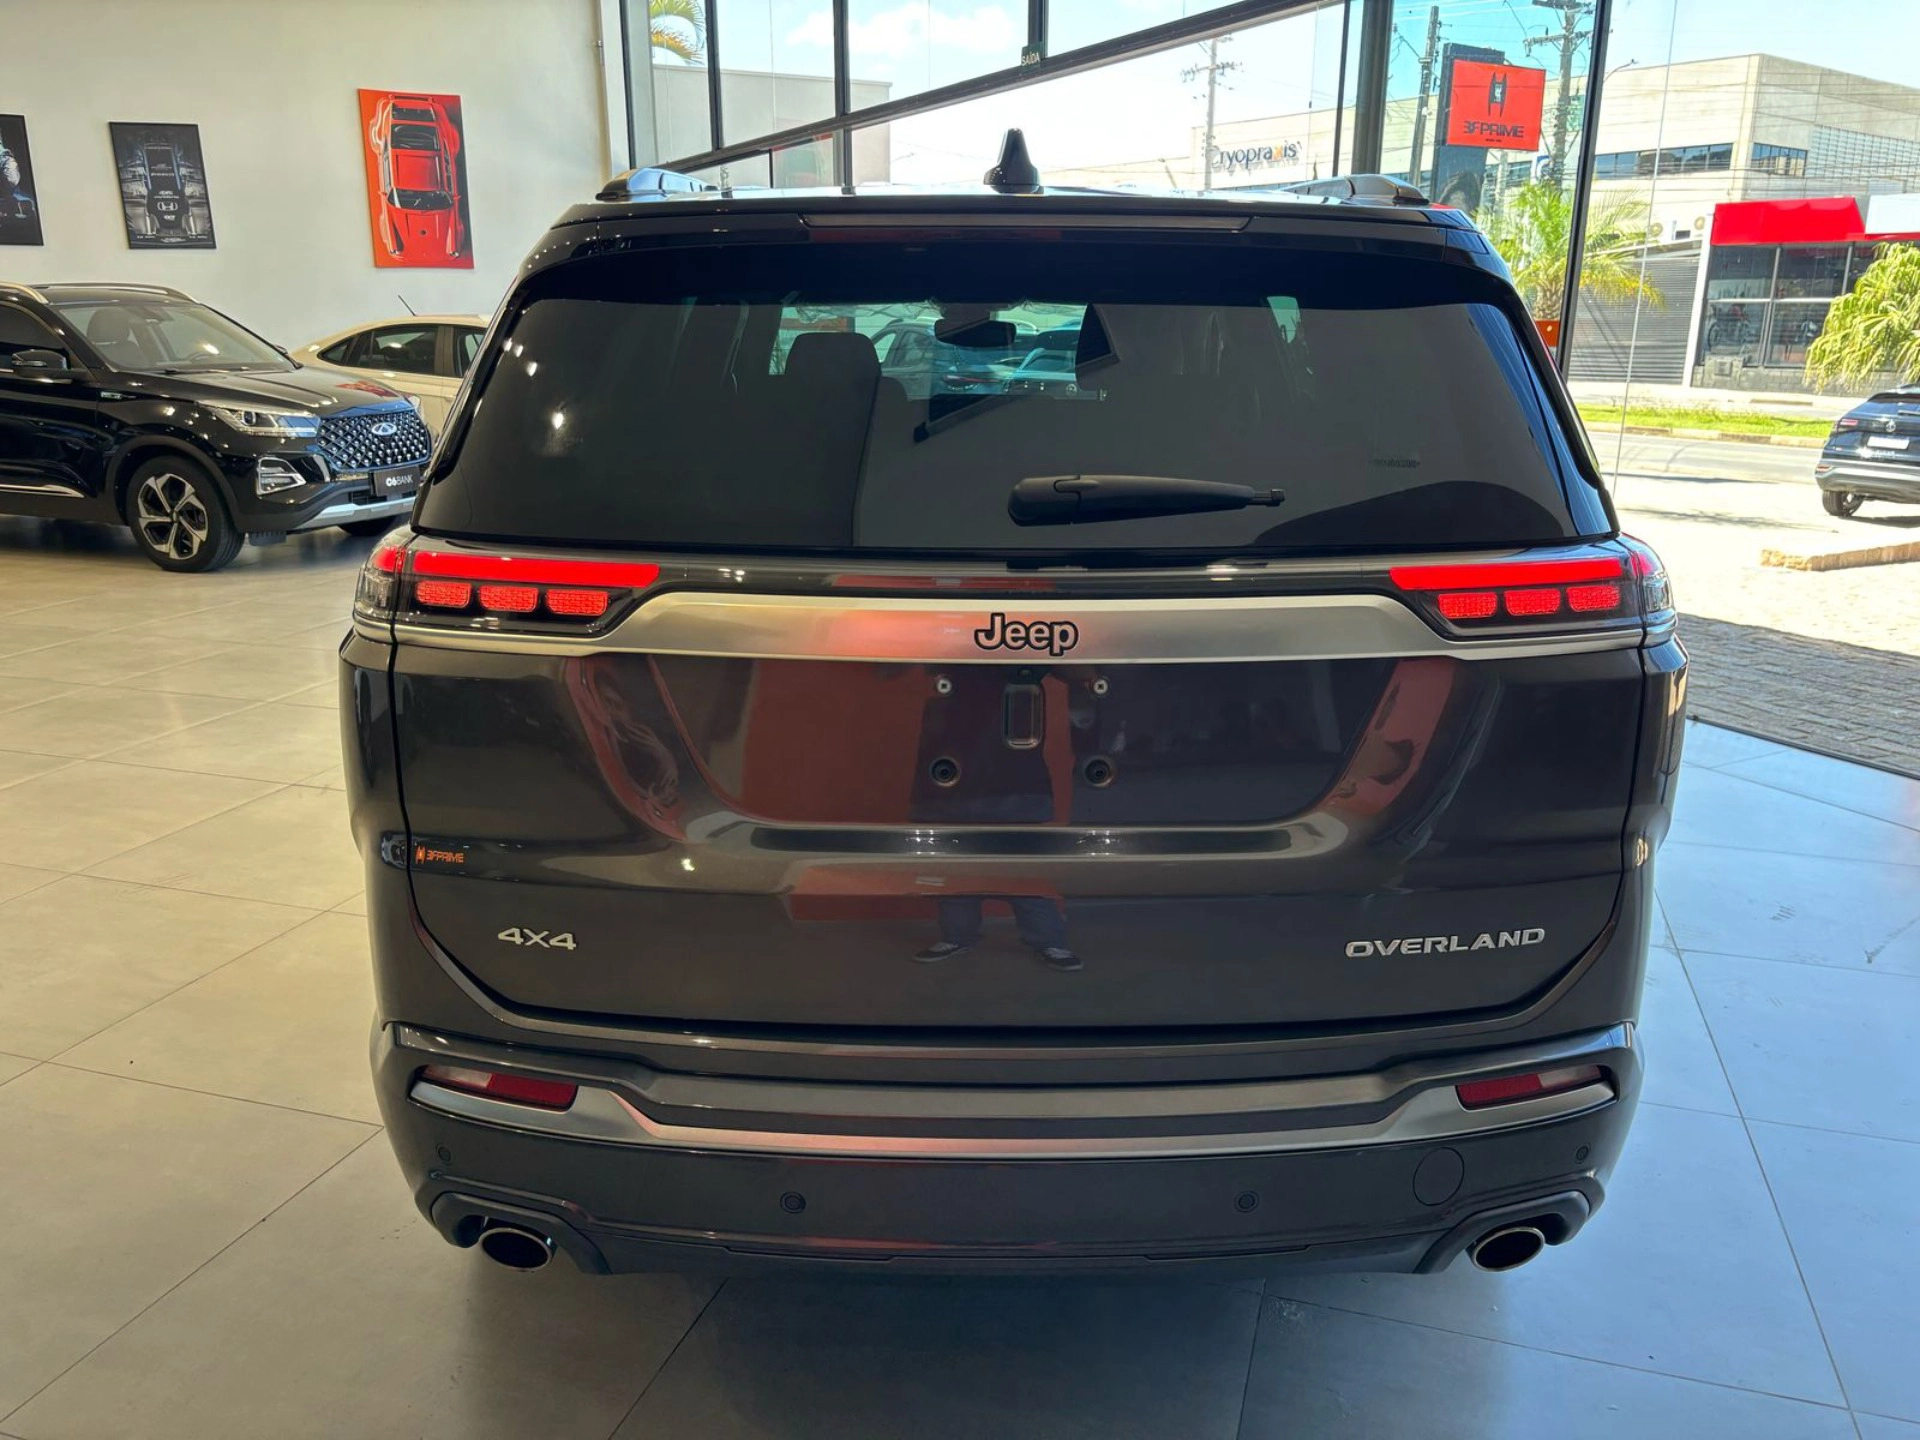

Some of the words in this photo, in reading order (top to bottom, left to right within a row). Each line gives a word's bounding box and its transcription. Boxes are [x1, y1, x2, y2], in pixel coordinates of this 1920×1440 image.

[974, 612, 1079, 656] Jeep
[497, 926, 577, 950] 4X4
[1345, 927, 1546, 958] OVERLAND
